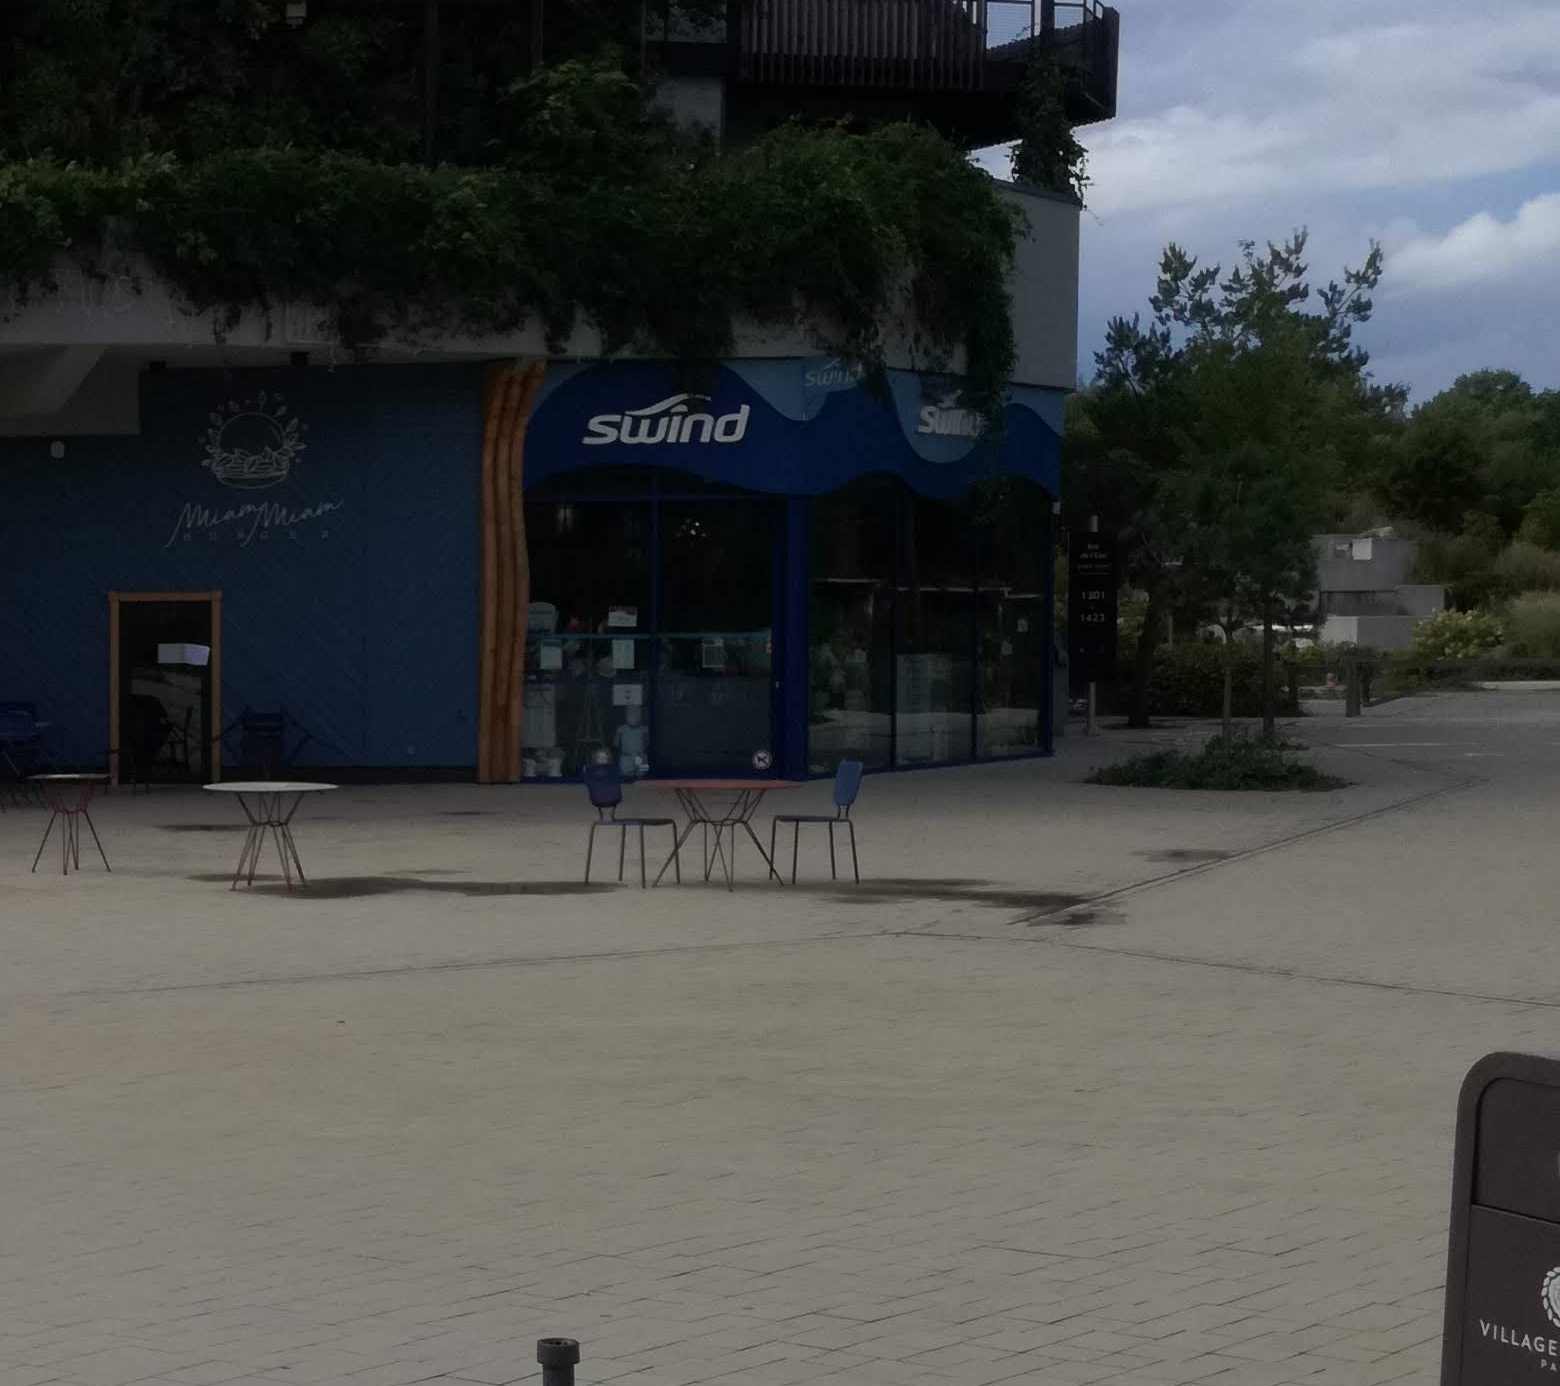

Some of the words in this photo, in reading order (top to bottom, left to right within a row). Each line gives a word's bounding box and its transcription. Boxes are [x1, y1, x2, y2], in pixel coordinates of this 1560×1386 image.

[582, 403, 751, 445] swind
[1081, 590, 1105, 600] 1301
[1080, 613, 1105, 623] 1423
